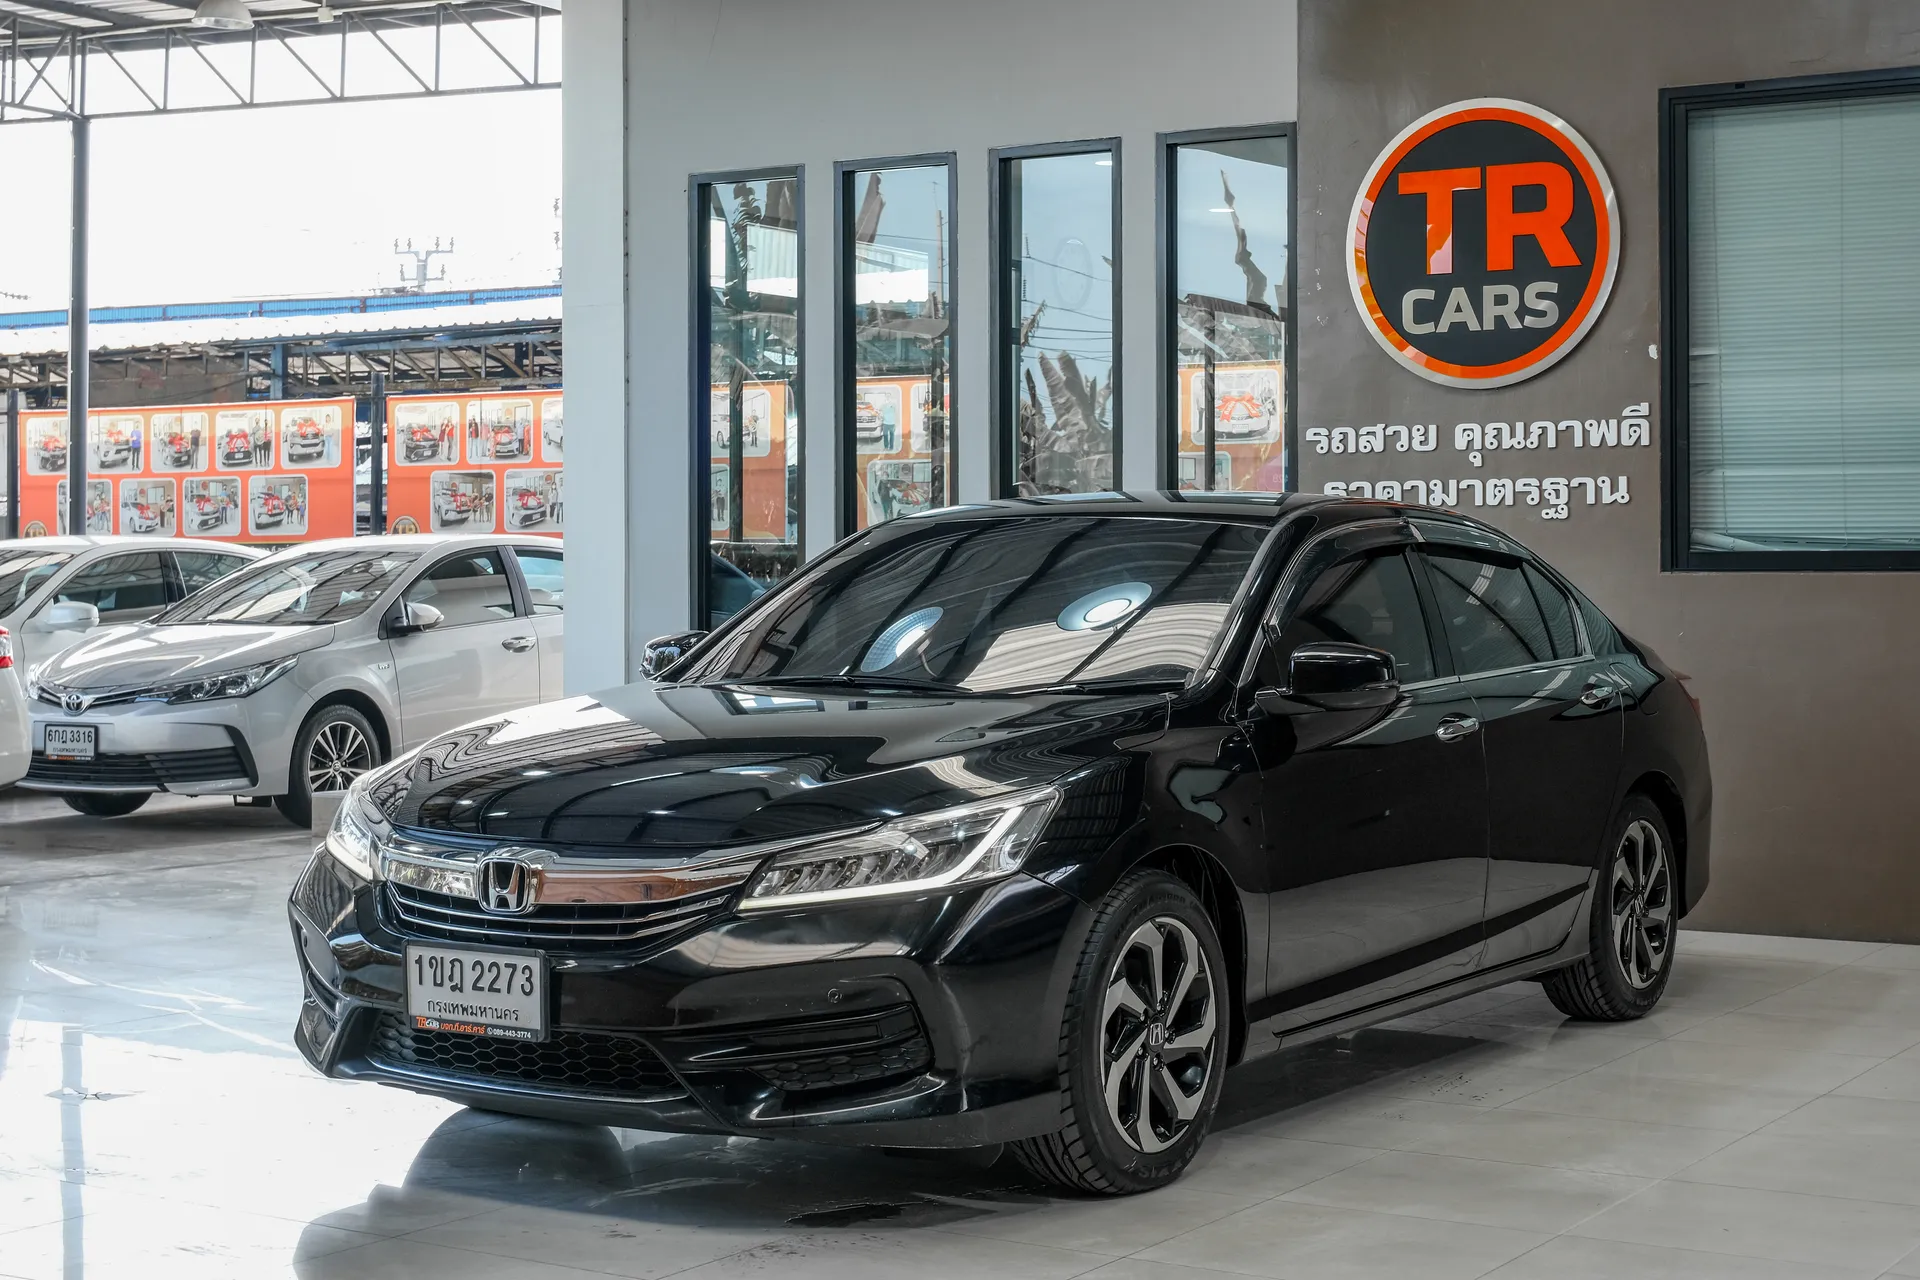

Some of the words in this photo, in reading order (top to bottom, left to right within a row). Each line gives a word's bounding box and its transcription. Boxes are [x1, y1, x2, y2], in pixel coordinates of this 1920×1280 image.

[1398, 161, 1582, 275] TR
[1401, 280, 1560, 335] CARS
[1305, 419, 1438, 454] รถสวย
[1454, 402, 1651, 468] คุณภาพดี
[69, 729, 93, 744] 3316
[414, 954, 464, 993] 1ขฎ
[471, 959, 534, 997] 2273
[427, 999, 520, 1022] กรุงเทพมหานคร
